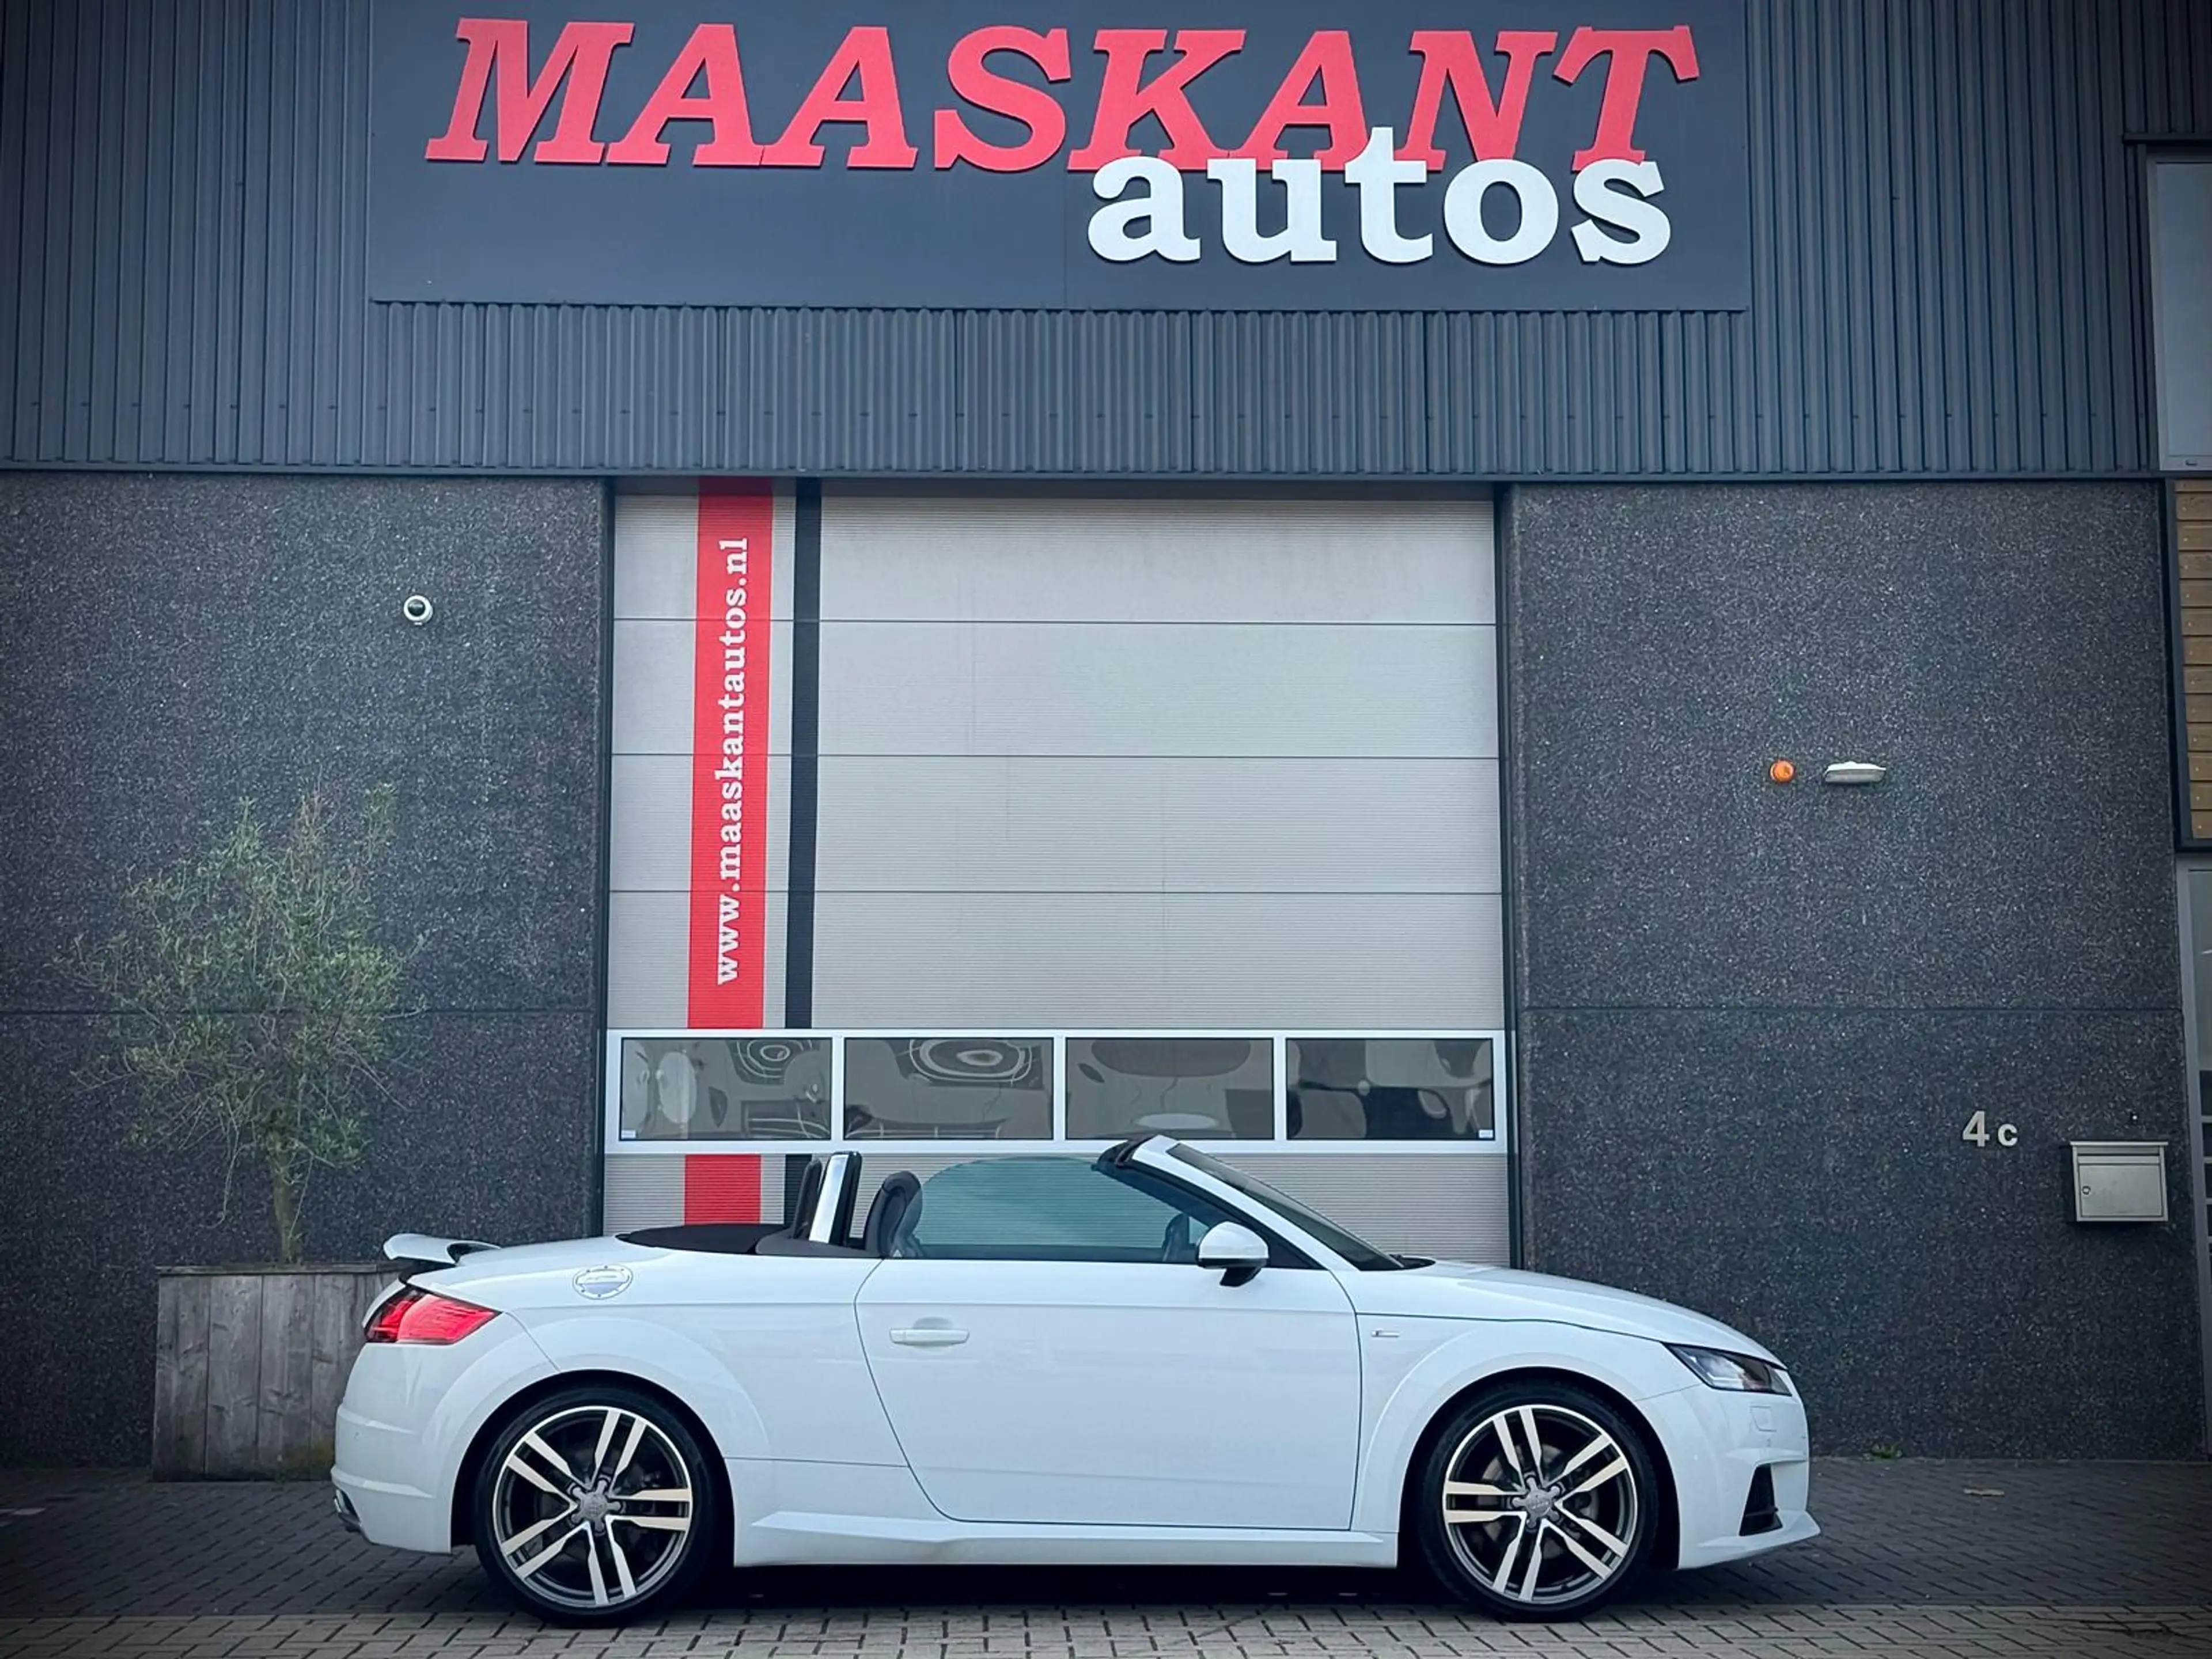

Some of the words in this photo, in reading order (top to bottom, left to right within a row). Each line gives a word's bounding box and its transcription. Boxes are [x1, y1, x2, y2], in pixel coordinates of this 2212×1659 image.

[426, 18, 1699, 172] MAASKANT
[1088, 127, 1671, 264] autos
[714, 537, 748, 985] www.maaskantautos.nl
